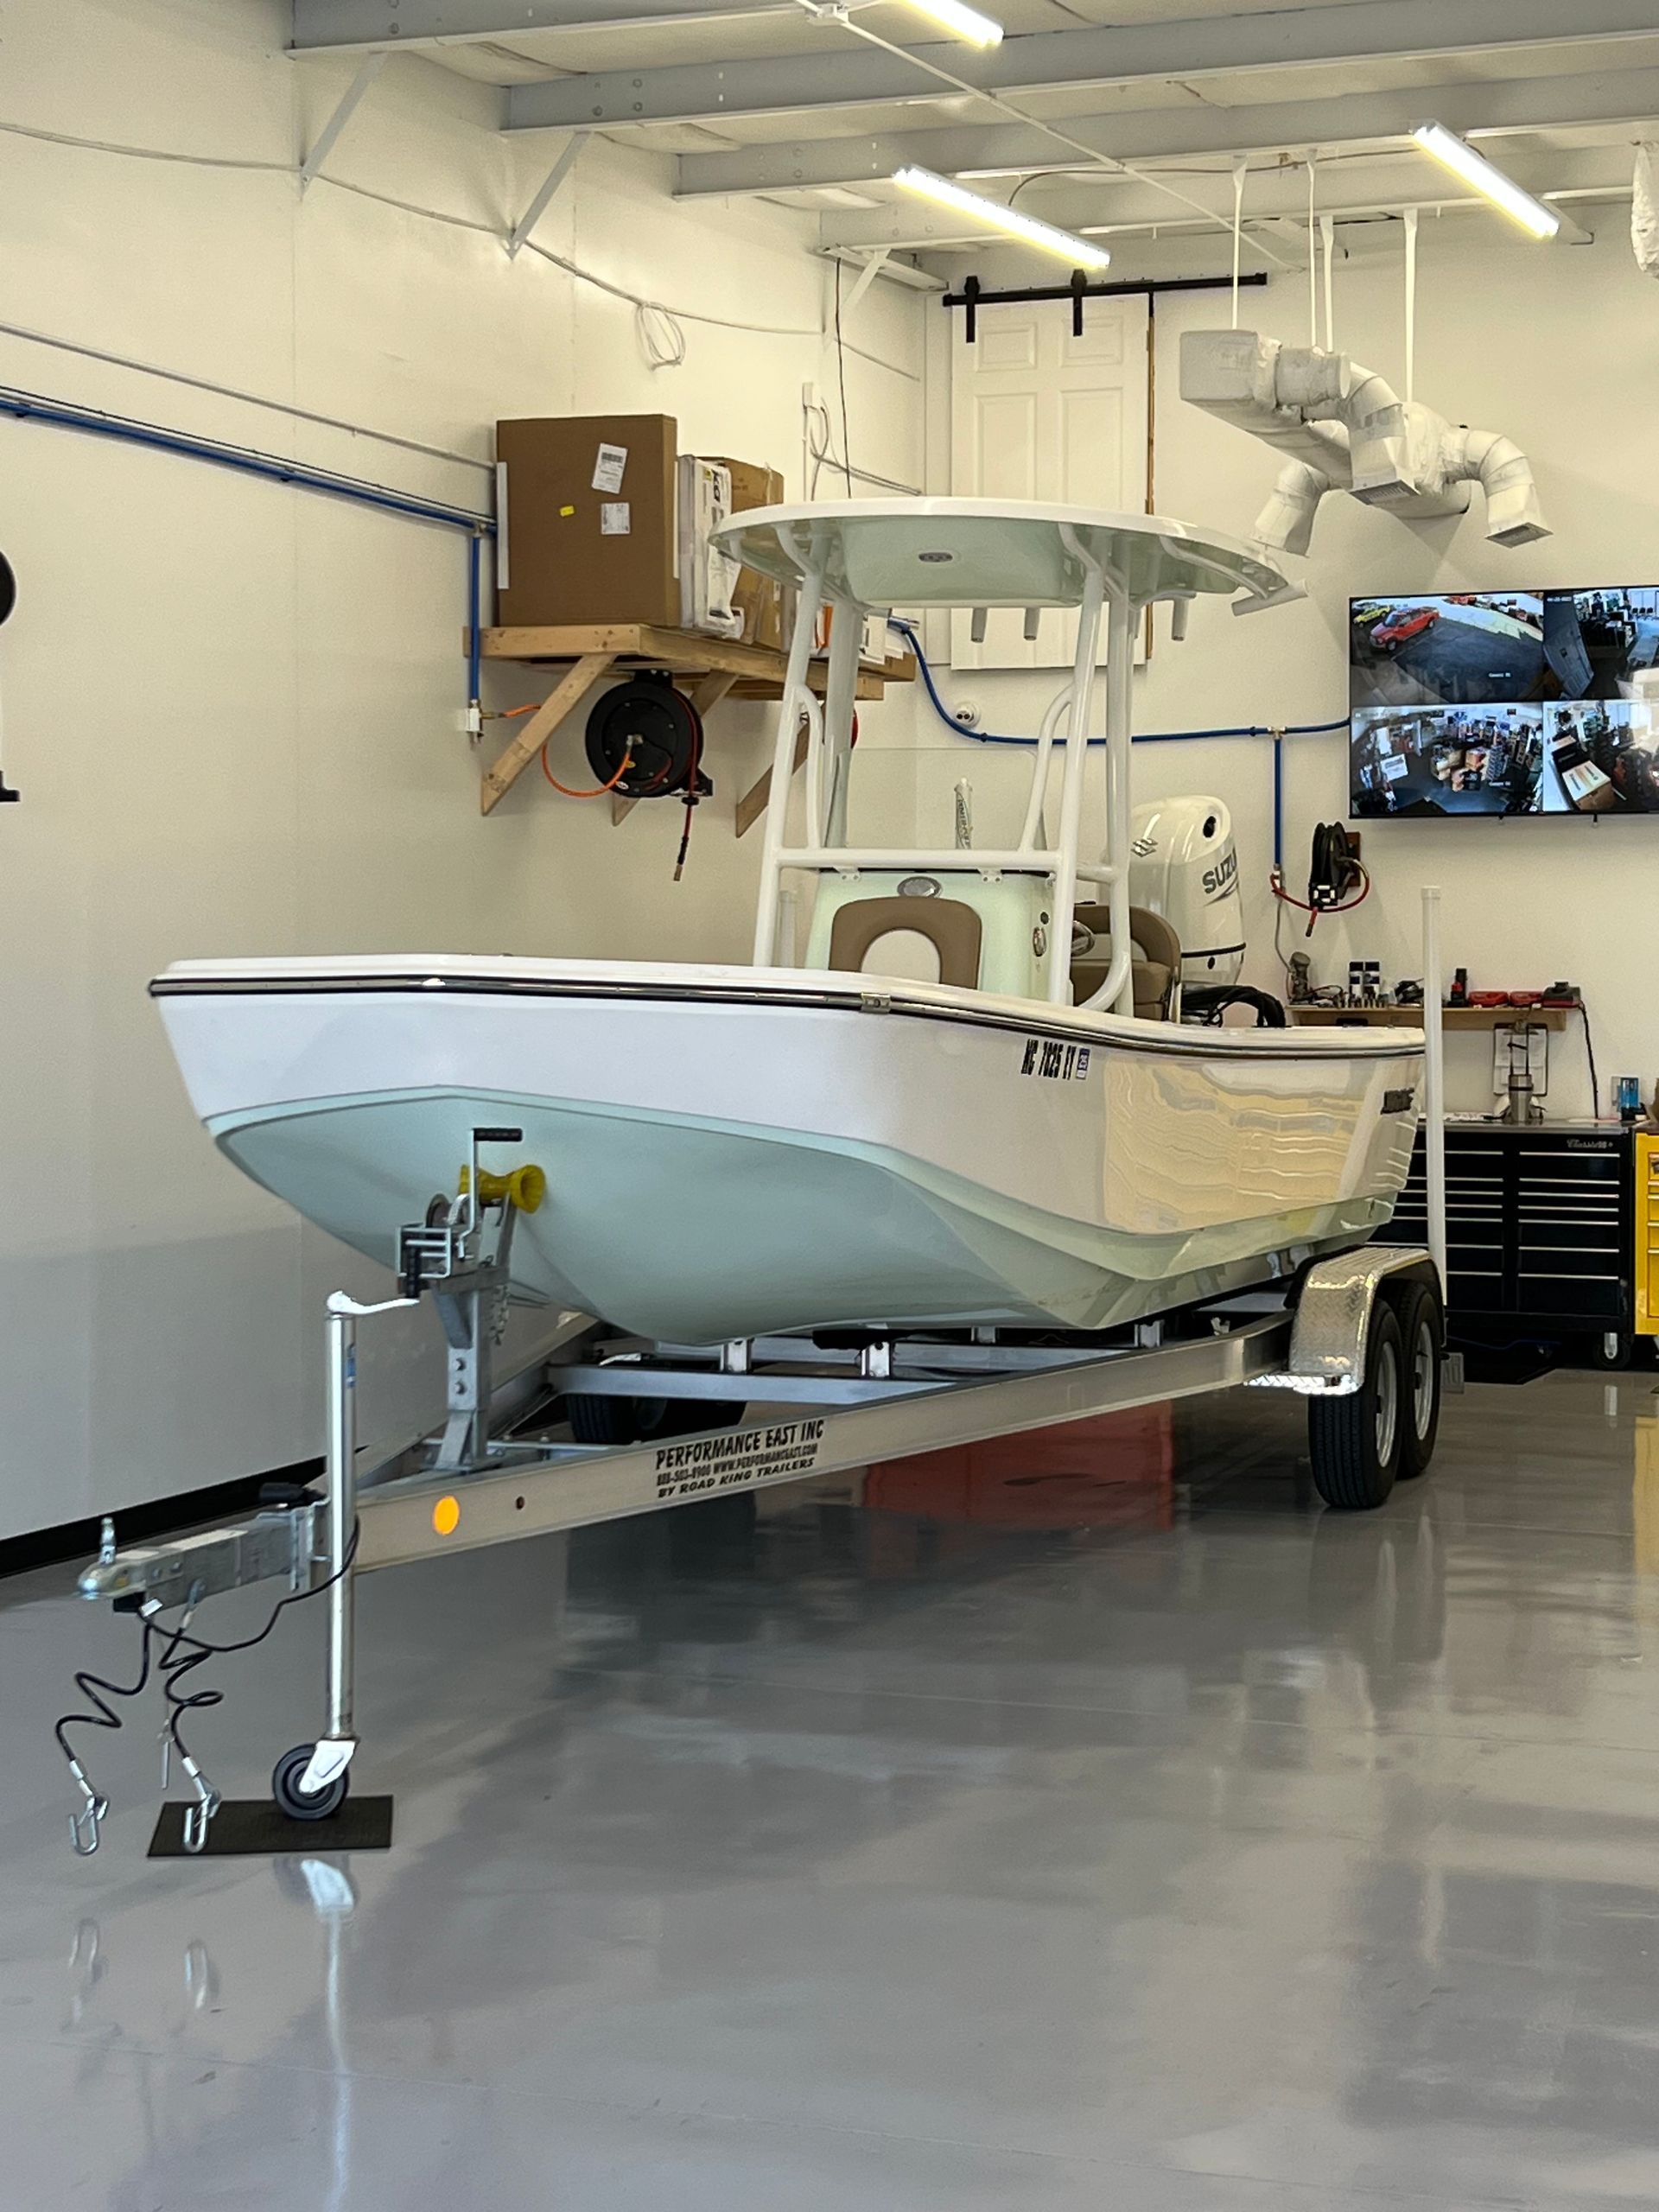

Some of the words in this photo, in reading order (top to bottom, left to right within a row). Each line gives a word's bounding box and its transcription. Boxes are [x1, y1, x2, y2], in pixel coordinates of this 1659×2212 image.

[657, 1431, 761, 1471] PERFORMANCE
[766, 1425, 798, 1449] EAST
[800, 1419, 824, 1442] INC
[658, 1486, 676, 1498] BY
[679, 1478, 715, 1494] ROAD
[720, 1470, 753, 1485] KING
[757, 1457, 815, 1478] TRAILERS
